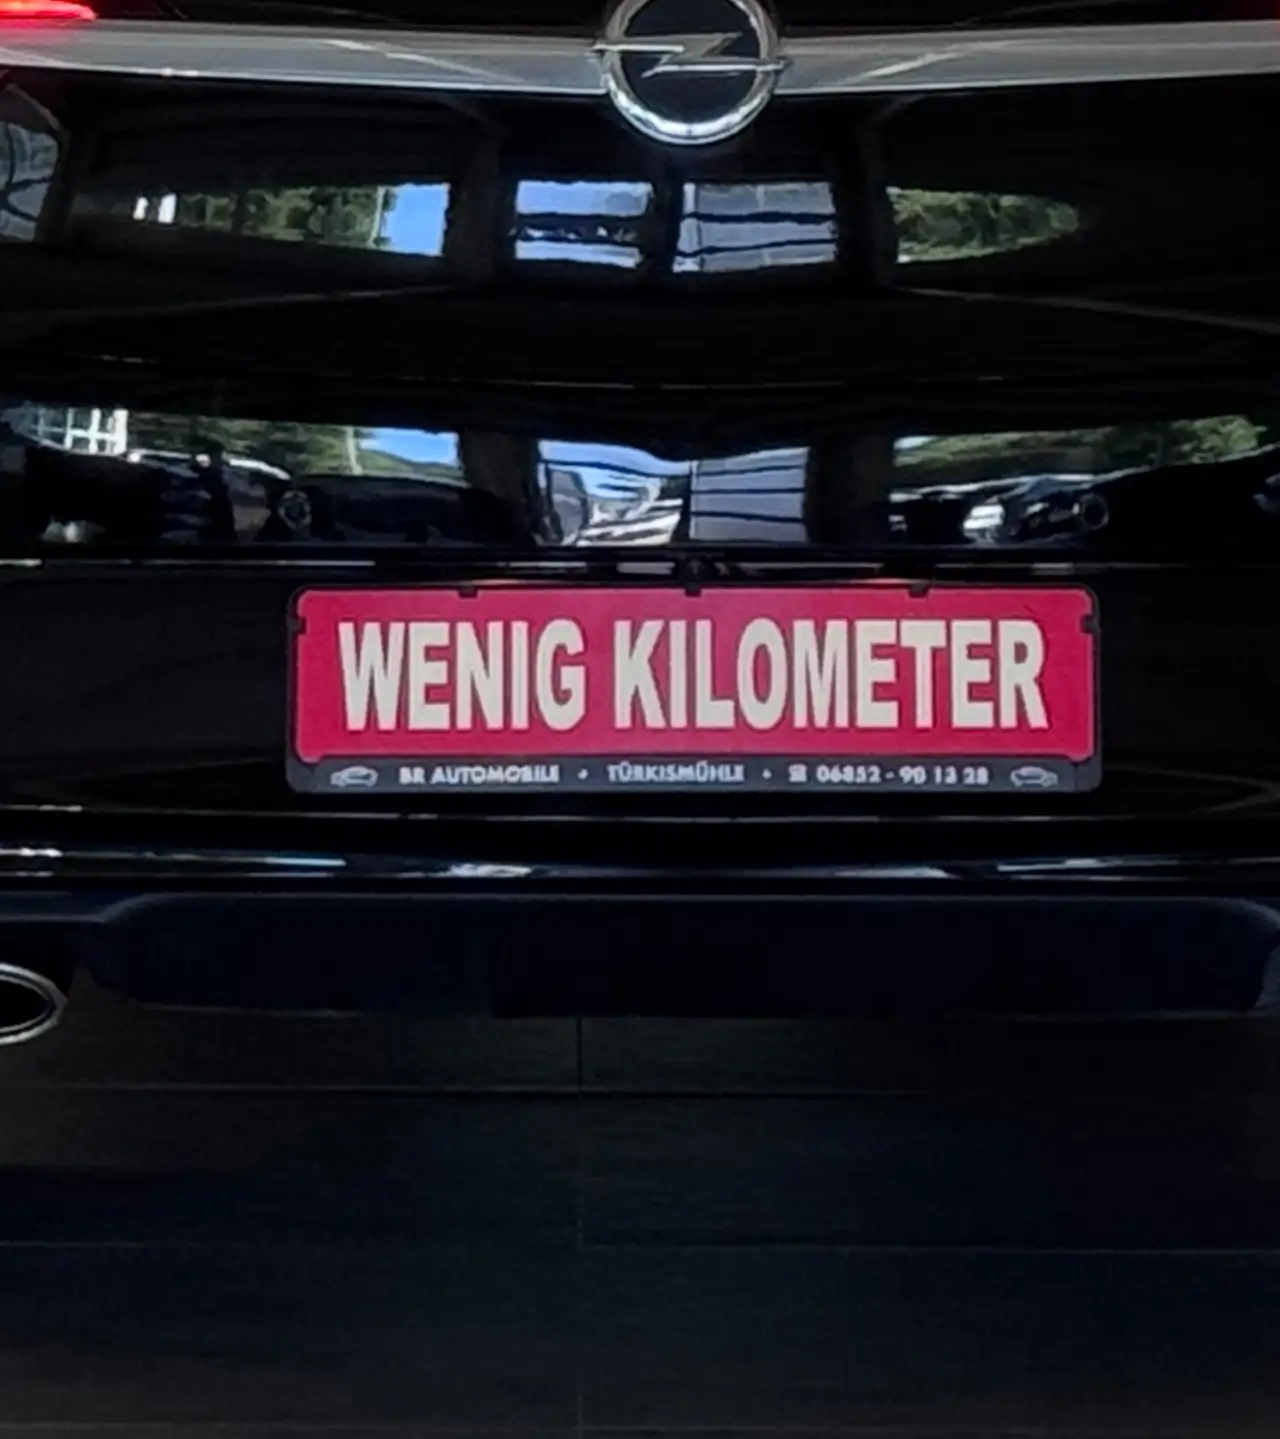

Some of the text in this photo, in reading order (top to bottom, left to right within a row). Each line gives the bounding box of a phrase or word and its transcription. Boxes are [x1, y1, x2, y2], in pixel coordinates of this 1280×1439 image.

[338, 618, 1048, 731] WENIG KILOMETER
[399, 766, 425, 784] BR
[430, 765, 559, 783] AUTOMOBILE
[607, 760, 745, 782] TÜRKISMÜHLE
